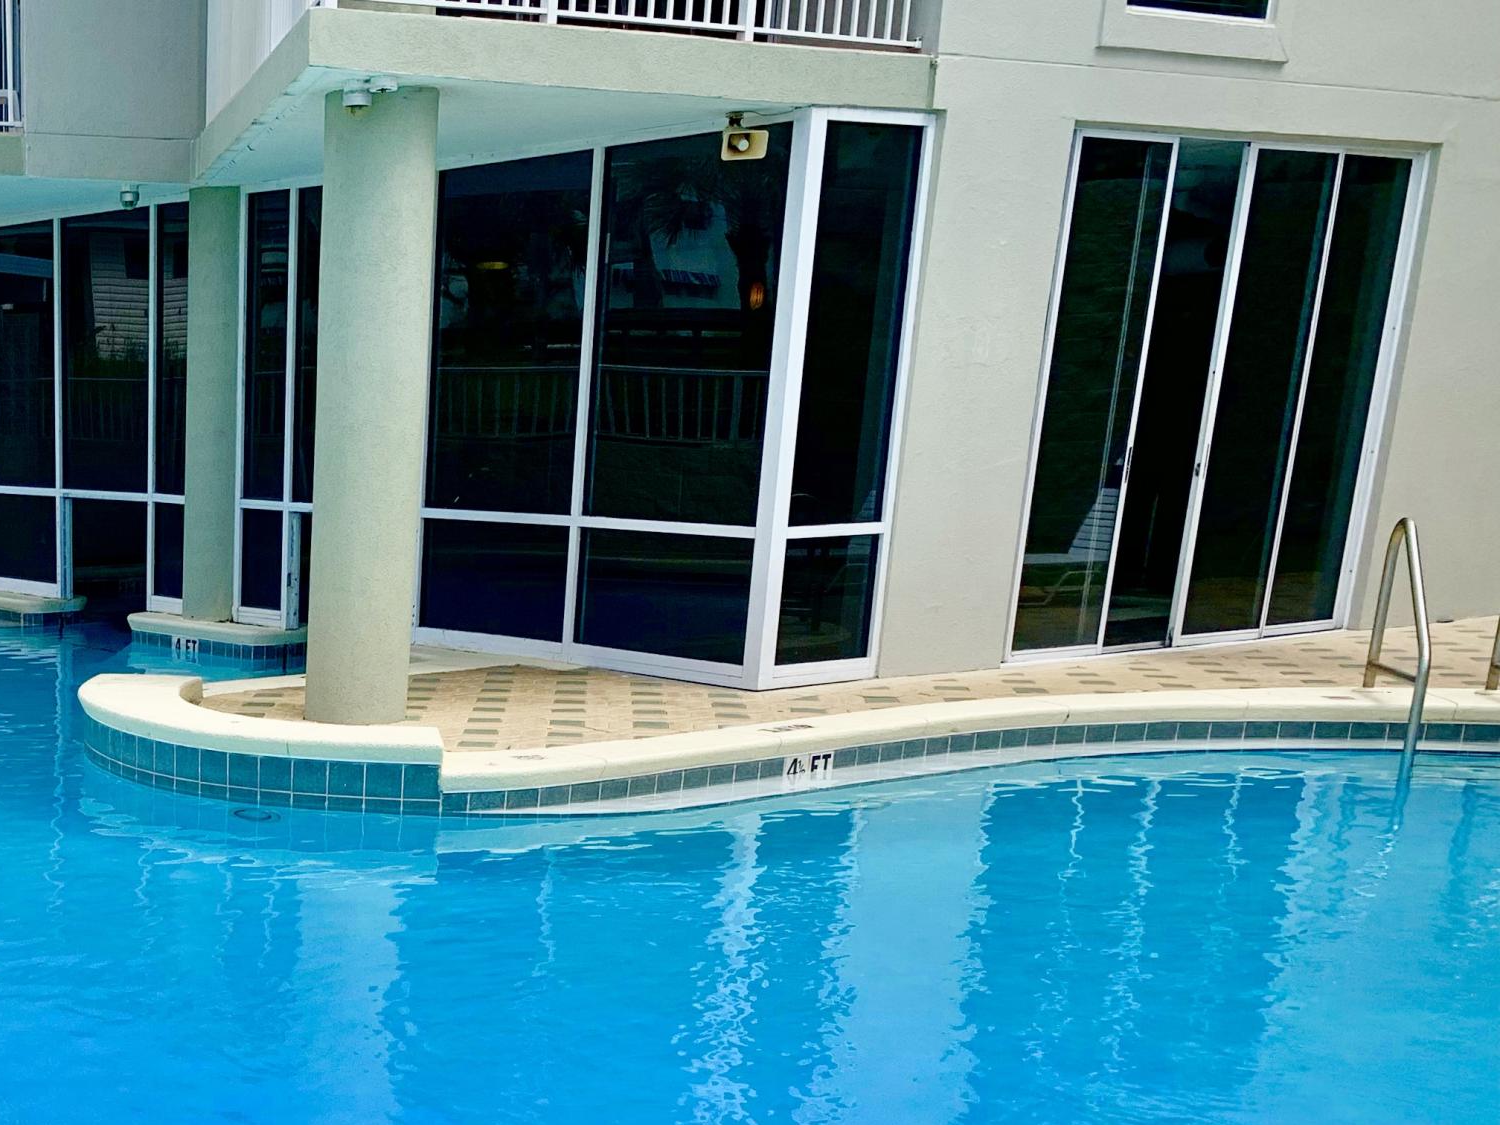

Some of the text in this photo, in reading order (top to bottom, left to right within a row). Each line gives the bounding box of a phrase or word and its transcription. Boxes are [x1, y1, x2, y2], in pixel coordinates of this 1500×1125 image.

[175, 637, 197, 651] 4 FT
[810, 753, 832, 772] FT
